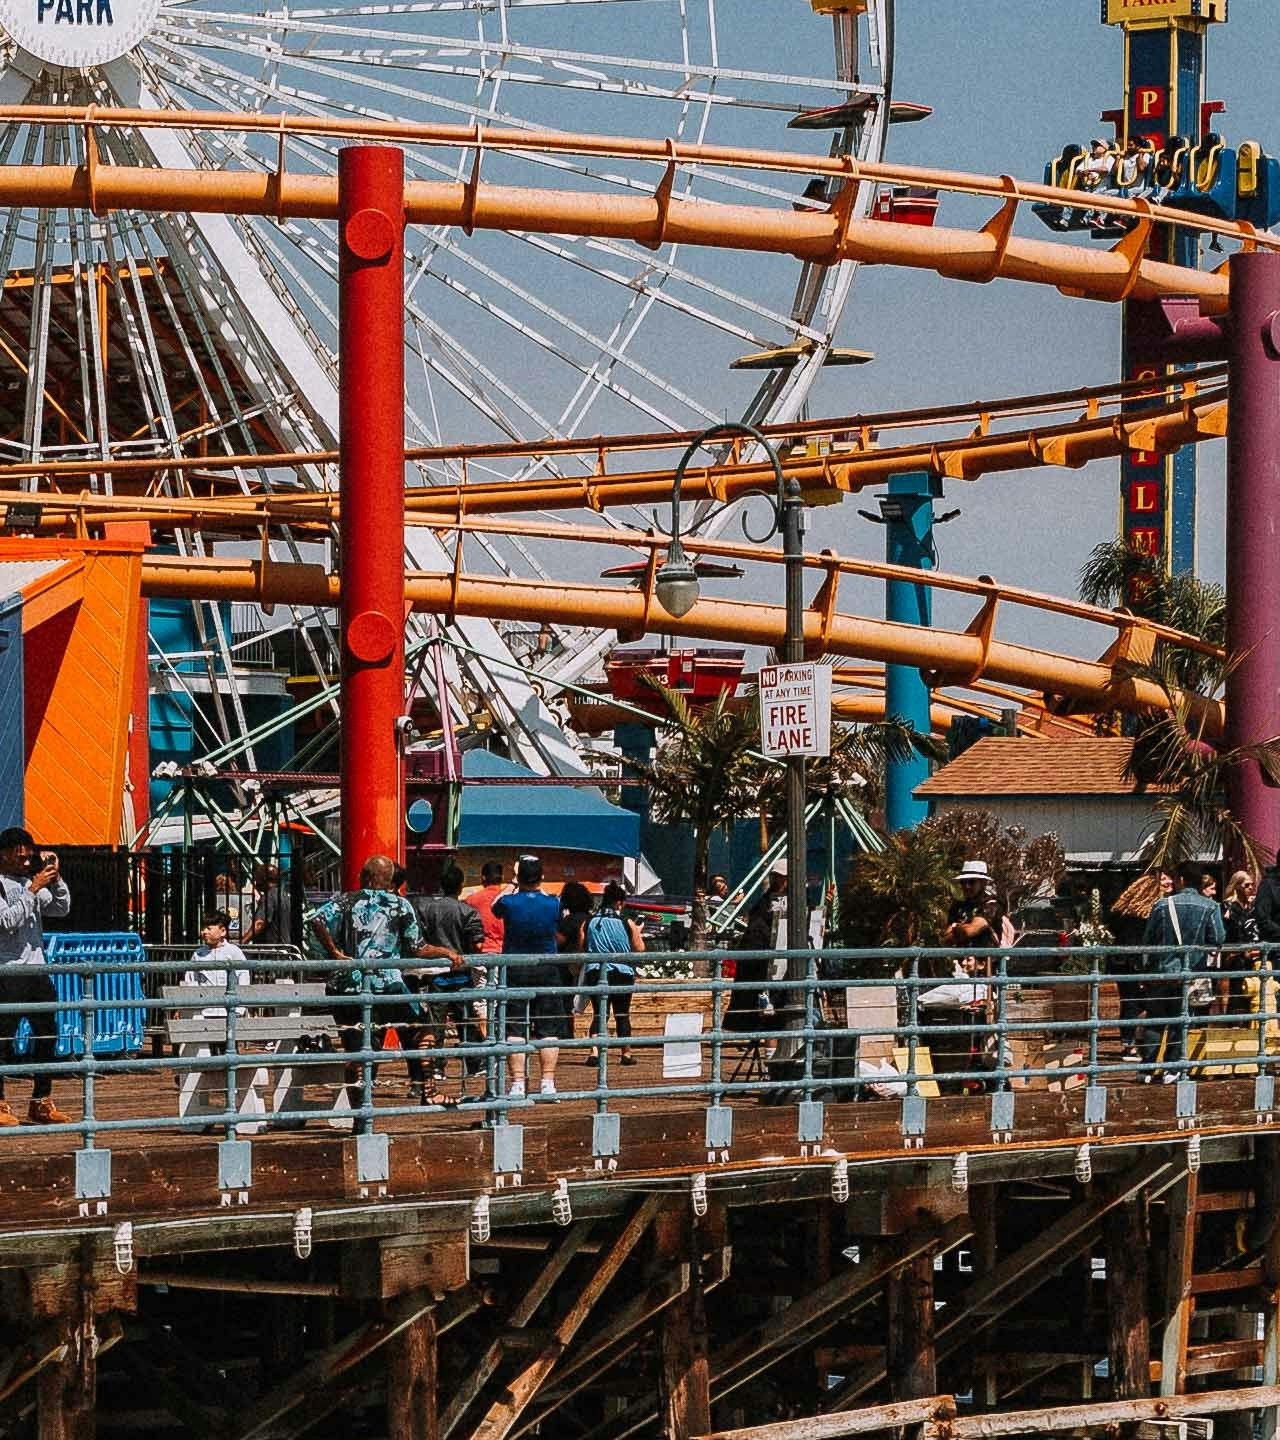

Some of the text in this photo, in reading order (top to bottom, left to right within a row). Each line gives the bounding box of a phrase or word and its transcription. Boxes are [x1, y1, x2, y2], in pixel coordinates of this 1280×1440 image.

[762, 668, 813, 686] NO PARKING
[765, 686, 812, 699] AT ANY TIME
[770, 704, 808, 727] FIRE
[767, 727, 812, 751] LANE
